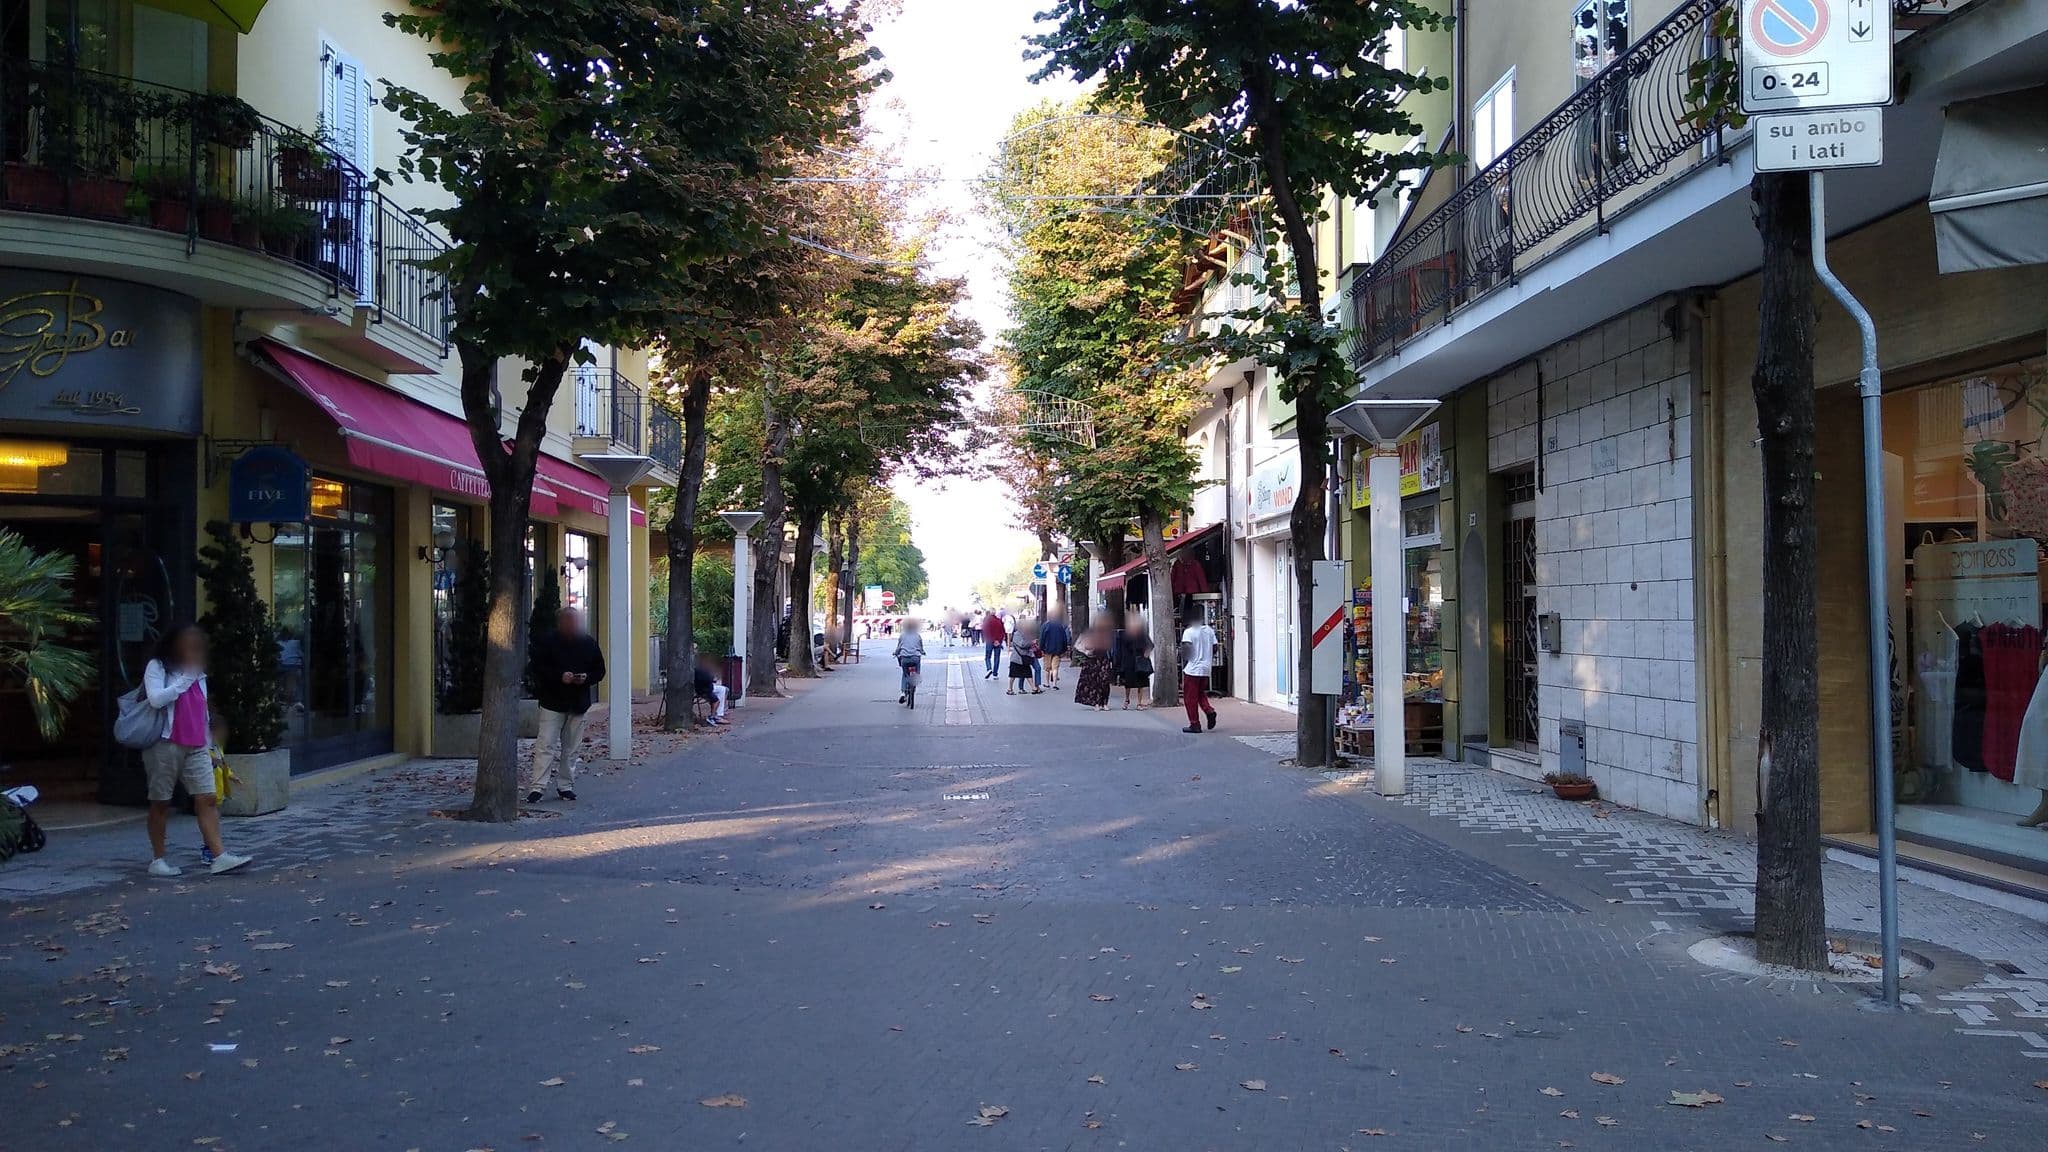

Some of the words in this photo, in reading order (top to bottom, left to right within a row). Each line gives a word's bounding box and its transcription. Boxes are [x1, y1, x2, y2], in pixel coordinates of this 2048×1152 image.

[1769, 123, 1794, 138] su
[1808, 118, 1866, 137] ambo
[1791, 145, 1797, 160] i
[1809, 142, 1845, 160] lati
[89, 391, 128, 409] 1954
[248, 489, 286, 501] FIVE
[1273, 486, 1293, 508] WIND
